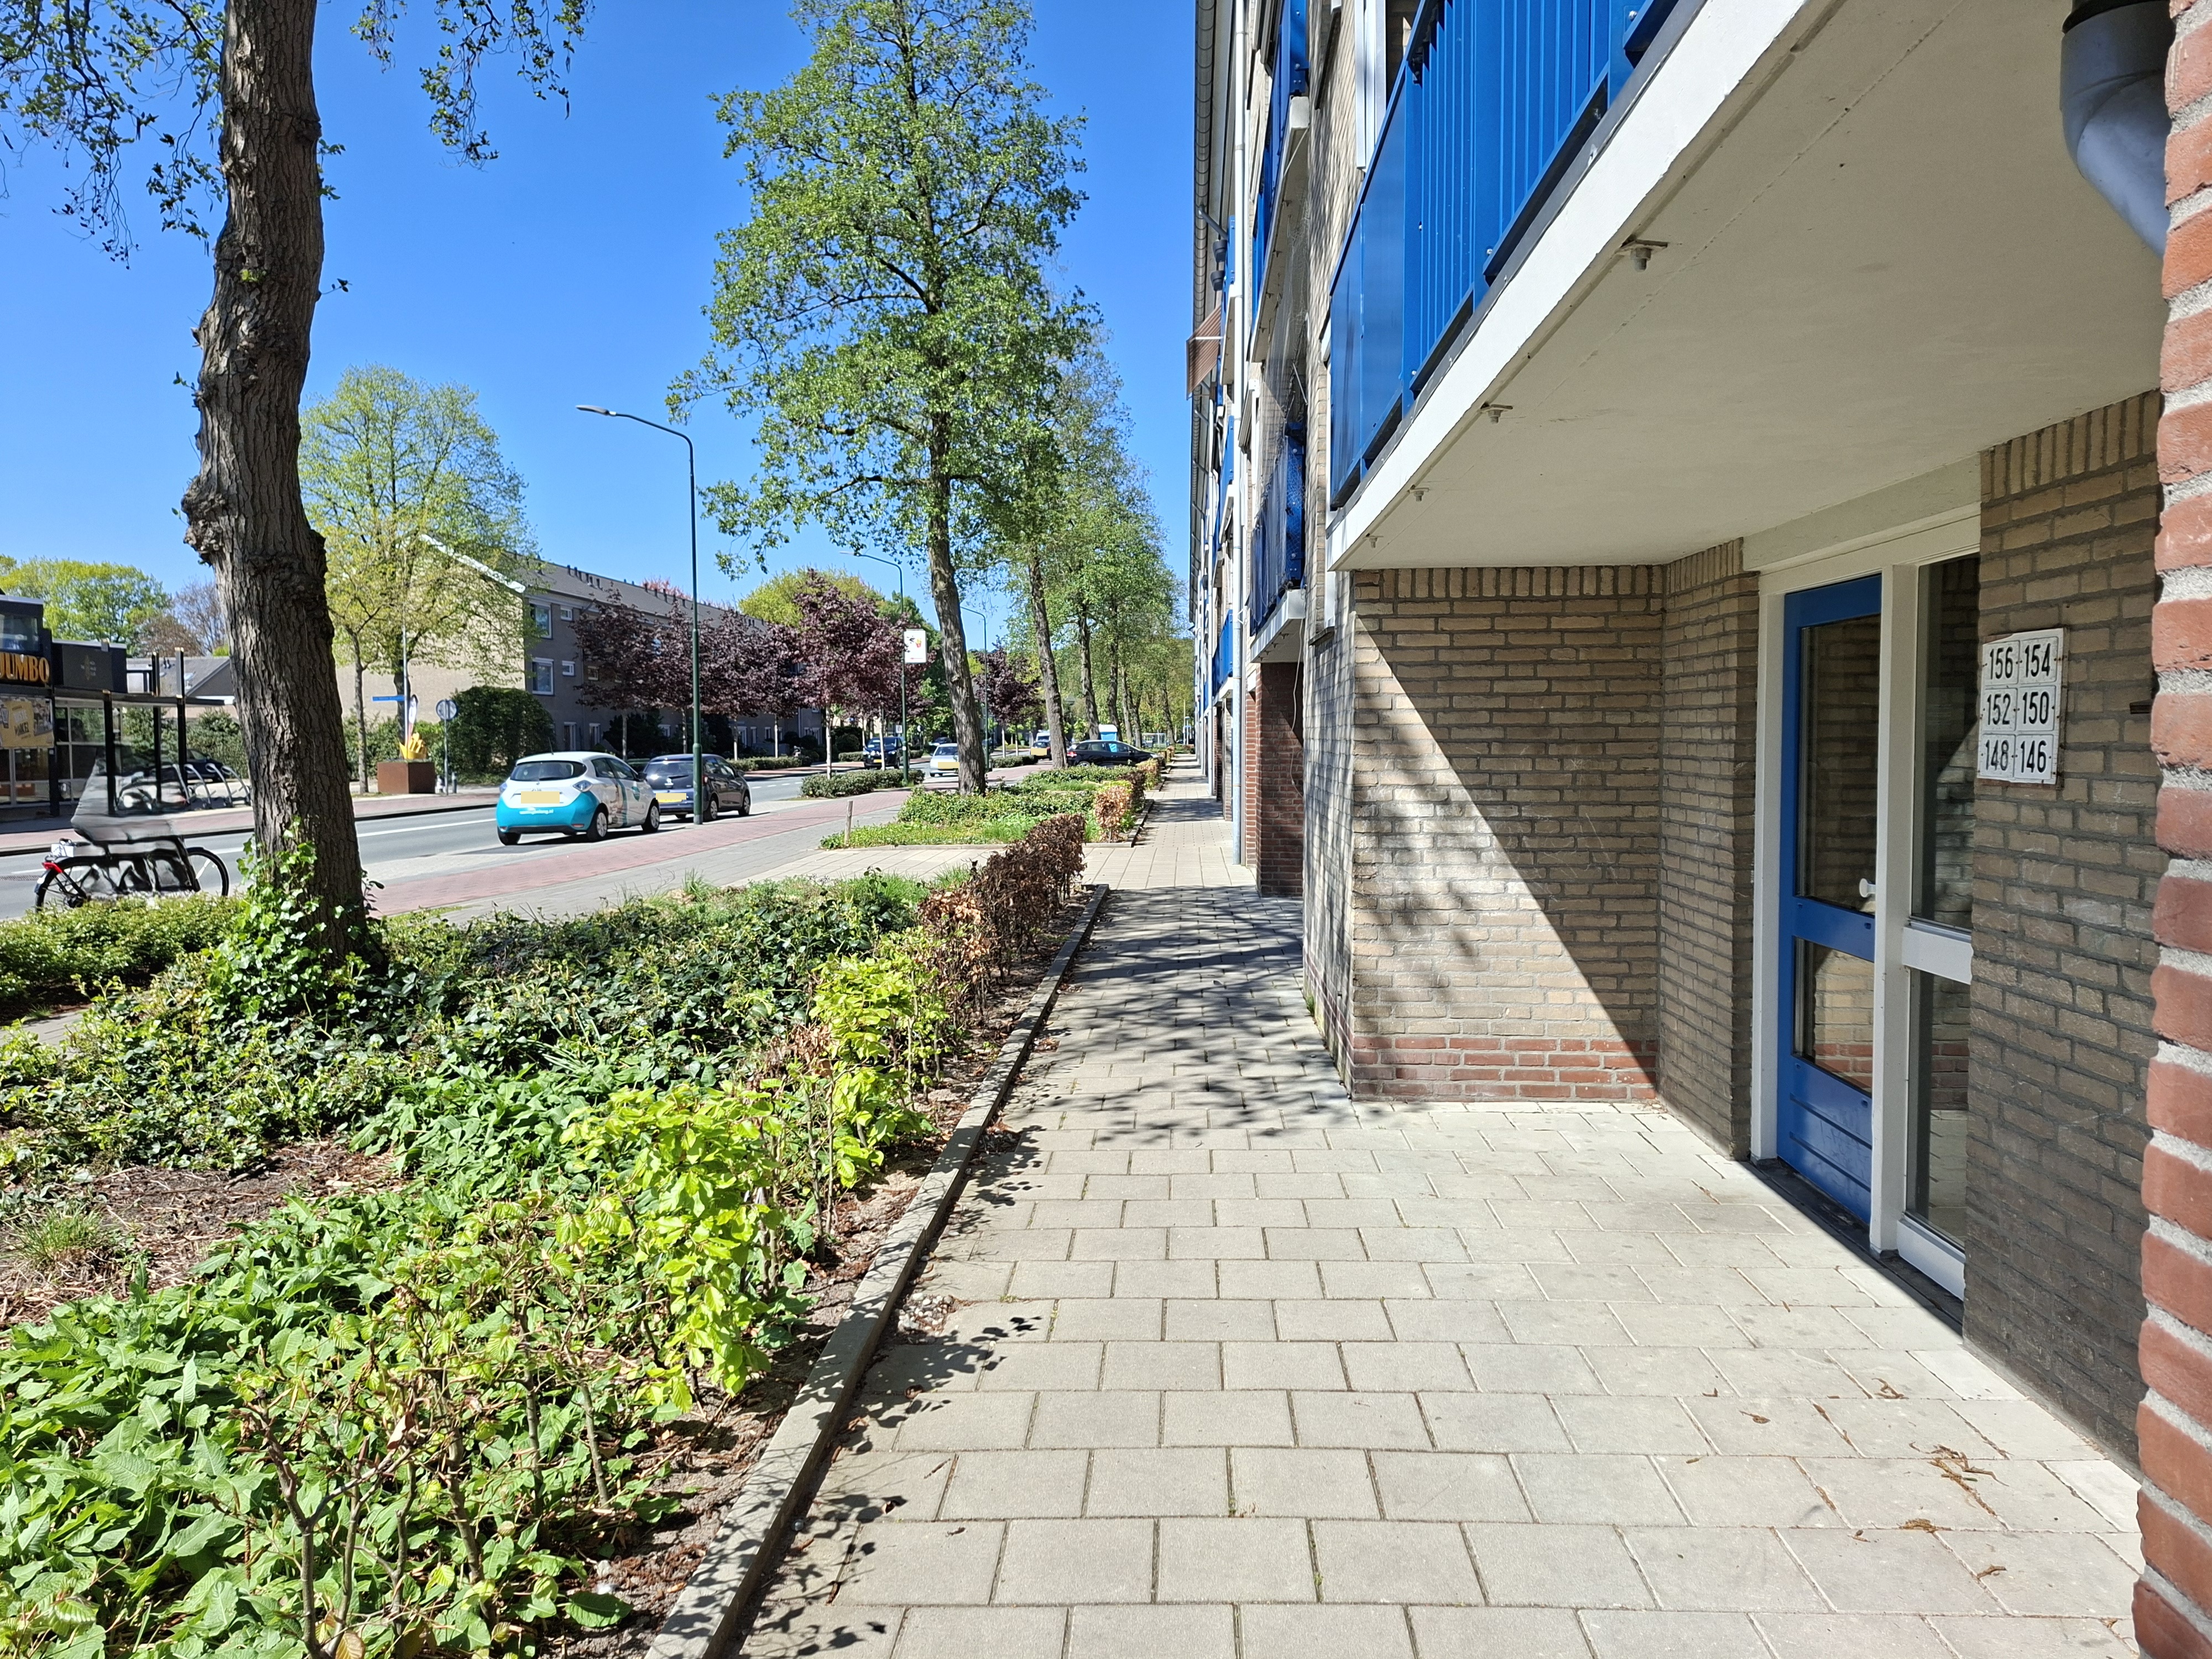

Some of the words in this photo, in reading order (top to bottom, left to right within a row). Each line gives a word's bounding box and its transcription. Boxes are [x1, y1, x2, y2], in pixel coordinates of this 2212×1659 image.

[1989, 646, 2013, 680] 156
[2025, 643, 2051, 677] 154
[1987, 693, 2011, 726] 152
[2022, 691, 2050, 724] 150
[1985, 739, 2009, 771] 148
[2020, 740, 2047, 773] 146
